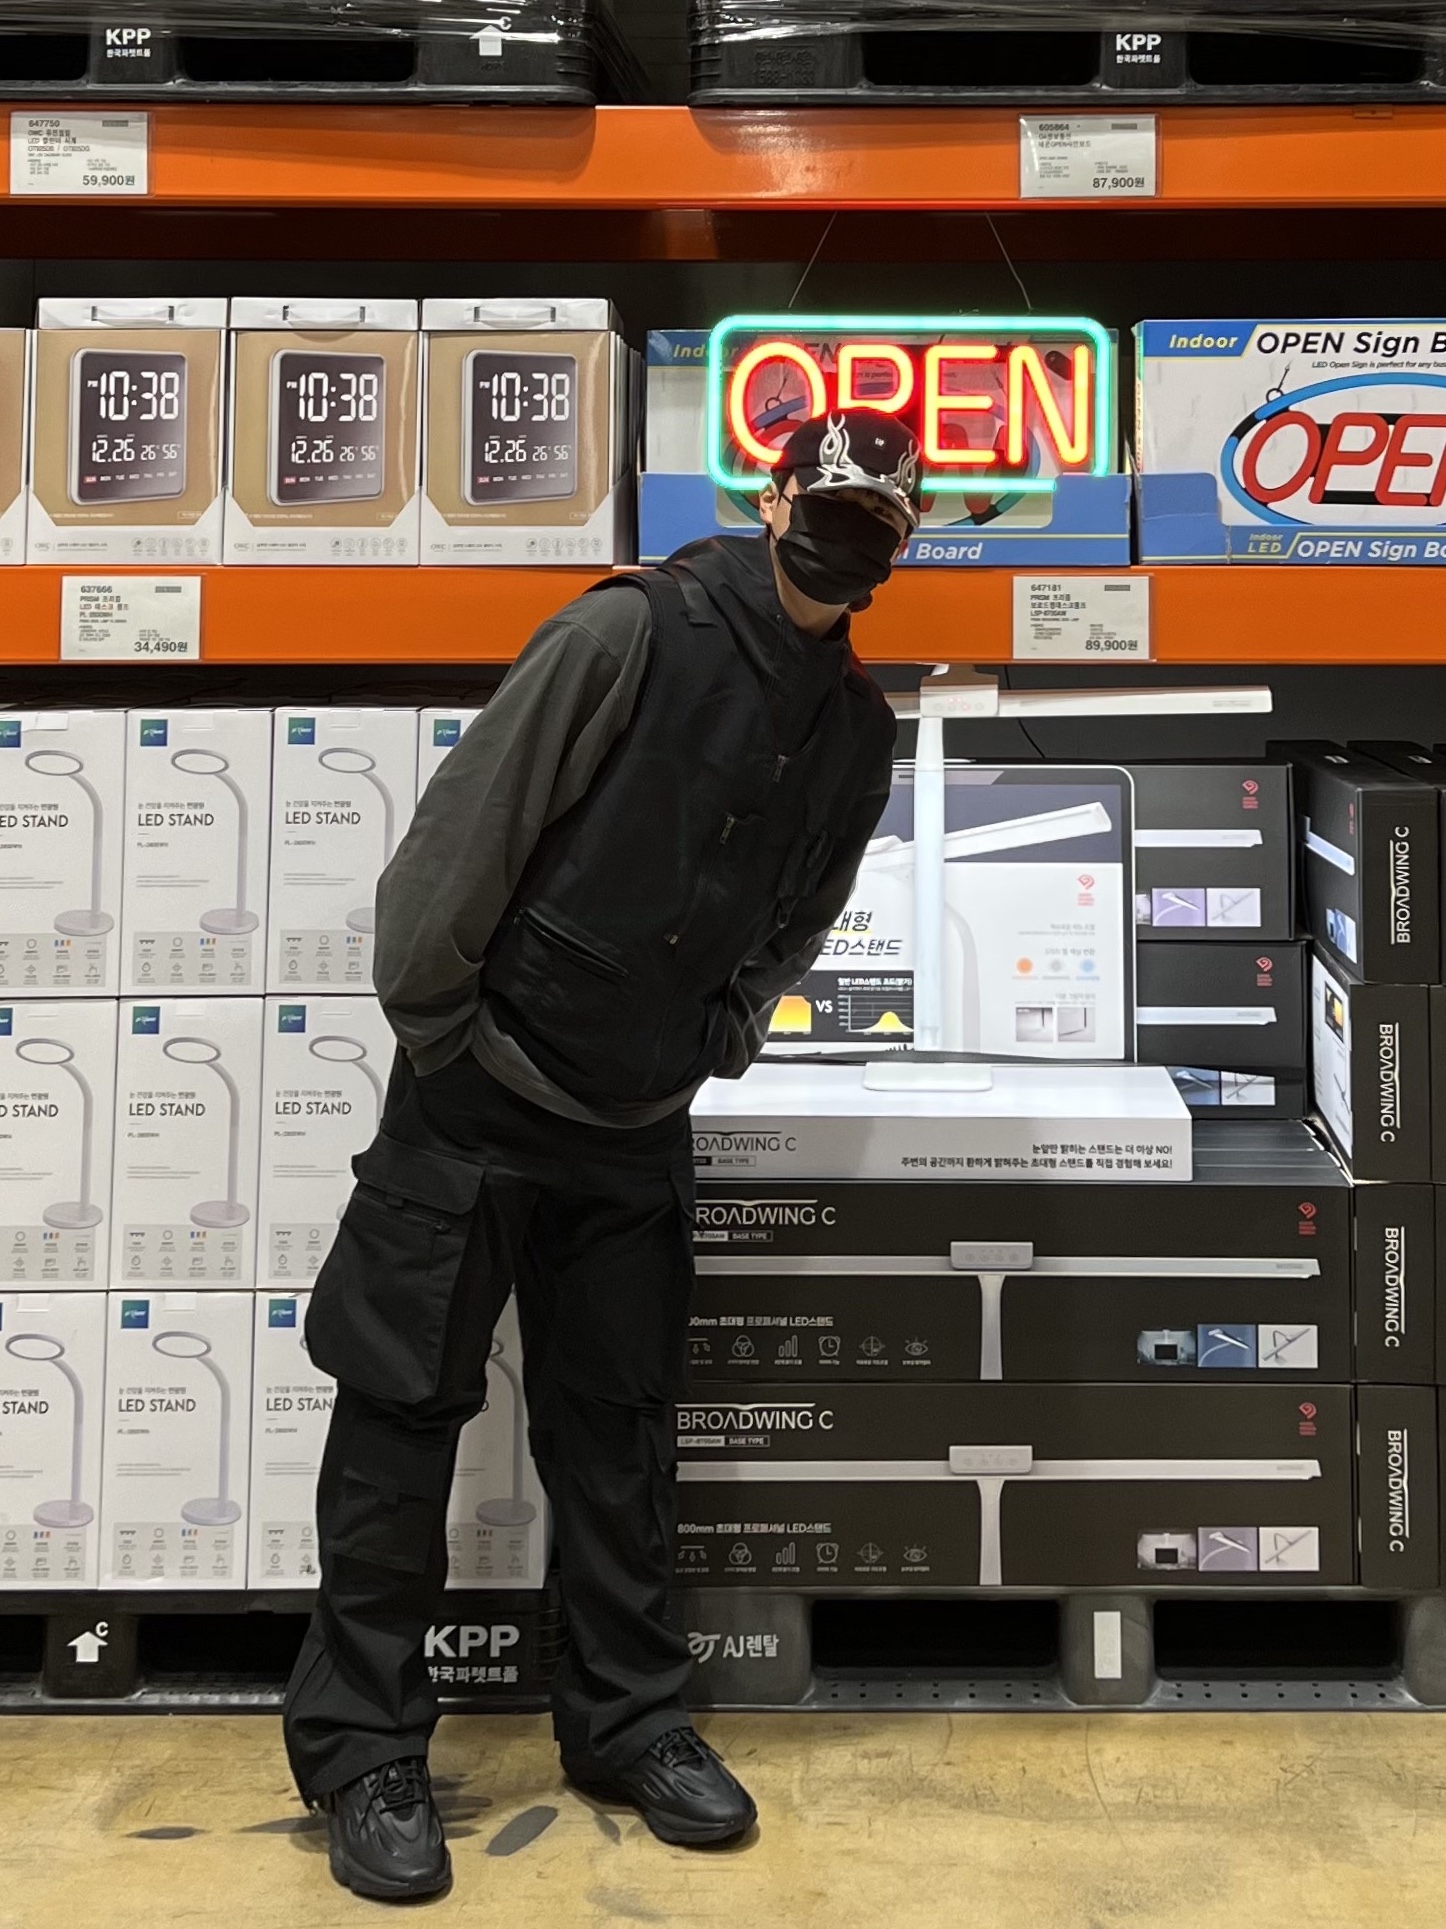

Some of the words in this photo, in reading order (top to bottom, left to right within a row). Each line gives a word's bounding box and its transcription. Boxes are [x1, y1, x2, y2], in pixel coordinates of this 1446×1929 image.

[106, 28, 151, 45] KPP
[1116, 34, 1161, 50] KPP
[83, 175, 135, 187] 59,900원
[1093, 177, 1145, 190] 87,900원
[1169, 334, 1240, 349] Indoor
[1257, 332, 1345, 354] OPEN
[1353, 331, 1420, 358] Sign
[100, 370, 180, 421] 10:38
[299, 372, 378, 422] 10:38
[491, 372, 570, 422] 10:38
[728, 340, 1090, 466] OPEN
[92, 438, 135, 463] 12.26
[291, 440, 334, 463] 12.26
[484, 439, 527, 463] 12.26
[1243, 411, 1446, 507] OPE
[916, 542, 983, 560] Board
[1248, 543, 1281, 553] LED
[1297, 541, 1362, 558] OPEN
[1368, 541, 1417, 561] Sign
[134, 641, 188, 653] 34,490원
[1085, 640, 1138, 652] 89,900원
[22, 815, 69, 828] STAND
[138, 814, 164, 827] LED
[168, 813, 214, 827] STAND
[285, 812, 311, 825] LED
[315, 811, 361, 825] STAND
[1395, 826, 1410, 838] C
[1396, 840, 1411, 943] BROADWING
[816, 1000, 833, 1013] VS
[1379, 1023, 1396, 1128] BROADWING
[12, 1104, 58, 1118] STAND
[129, 1103, 155, 1116] LED
[159, 1103, 206, 1116] STAND
[275, 1102, 301, 1115] LED
[305, 1101, 352, 1115] STAND
[1381, 1130, 1395, 1143] C
[693, 1137, 780, 1151] OADWING
[785, 1137, 796, 1151] C
[1088, 1144, 1123, 1155] 스탠드는
[1125, 1145, 1134, 1155] 더
[1136, 1145, 1153, 1155] 이상
[1155, 1146, 1172, 1155] NO!
[1031, 1158, 1057, 1168] 초대형
[1059, 1158, 1093, 1168] 스탠드를
[1144, 1158, 1172, 1169] 보세요!
[695, 1206, 816, 1226] ROADWING
[822, 1206, 836, 1226] C
[1385, 1227, 1400, 1333] BROADWING
[790, 1316, 833, 1327] LED스탠드
[1386, 1335, 1400, 1348] C
[2, 1401, 49, 1414] STAND
[118, 1399, 145, 1412] LED
[150, 1398, 196, 1412] STAND
[266, 1398, 293, 1411] LED
[677, 1411, 813, 1430] BROADWING
[819, 1411, 834, 1429] C
[1388, 1430, 1404, 1538] BROADWING
[677, 1523, 714, 1534] 800mm
[787, 1522, 832, 1533] LED스탠드
[1389, 1541, 1404, 1553] C
[96, 1621, 108, 1637] C
[424, 1625, 520, 1657] KPP
[723, 1633, 779, 1658] AJ렌탈
